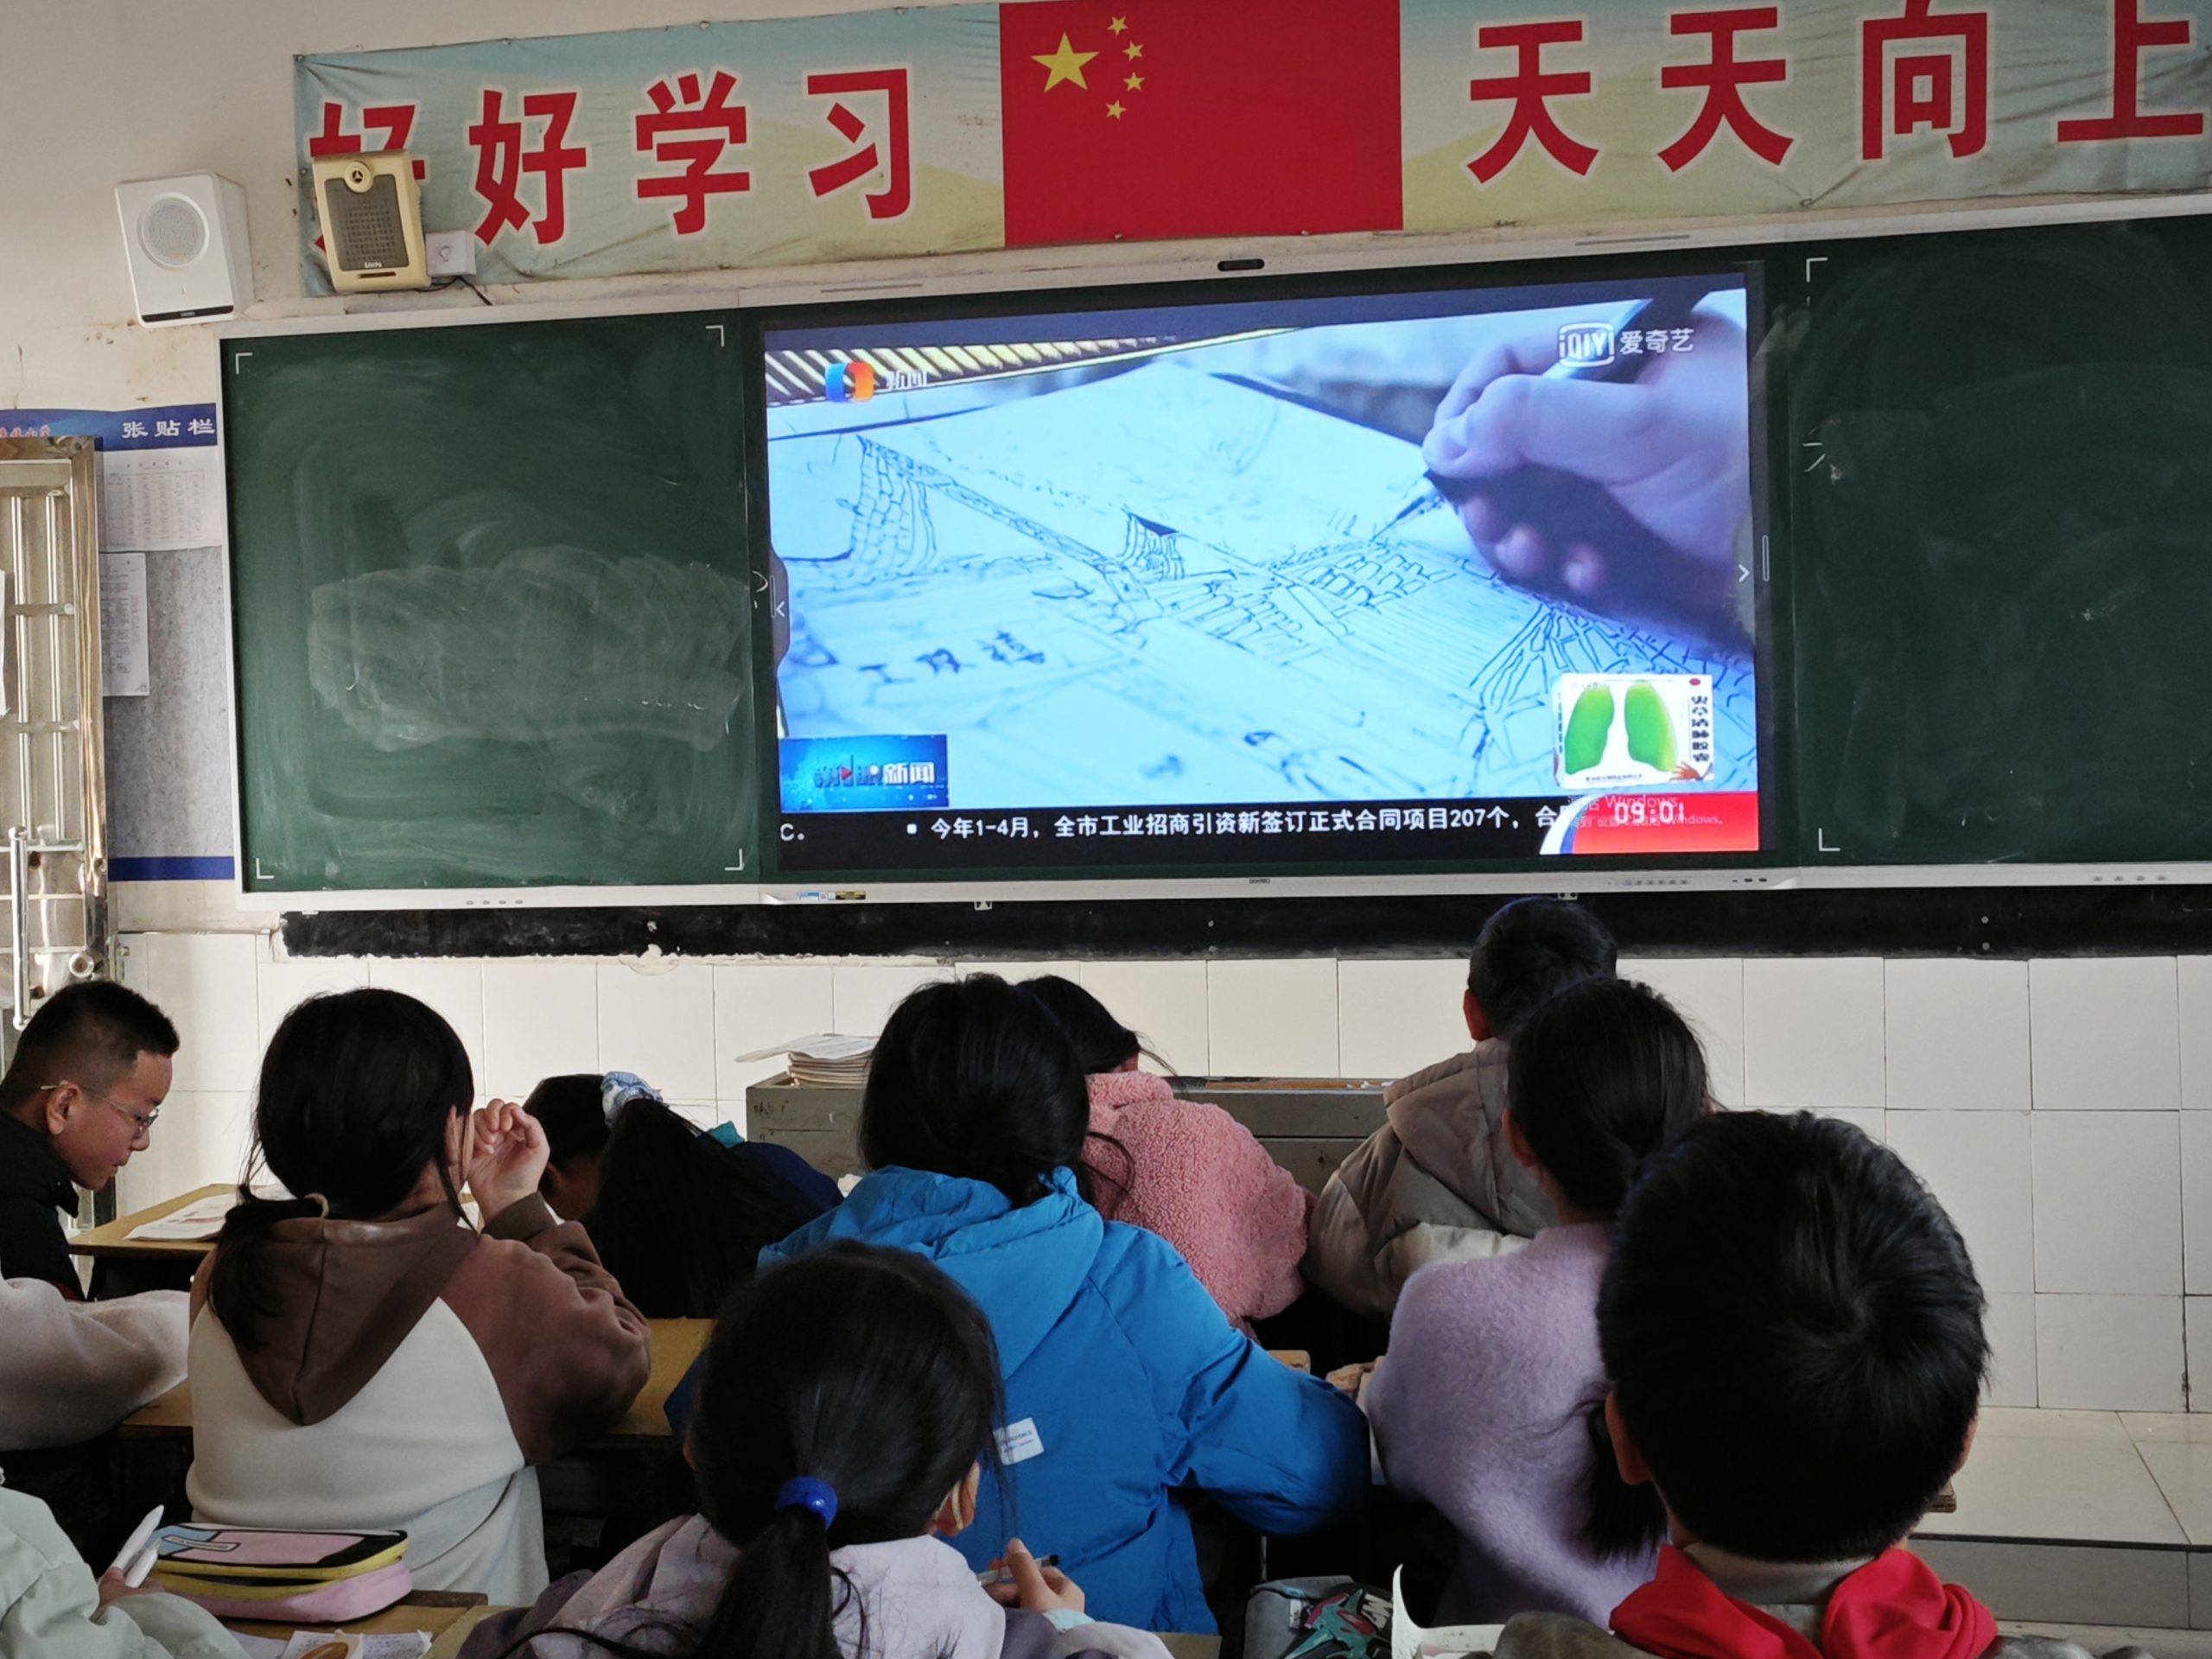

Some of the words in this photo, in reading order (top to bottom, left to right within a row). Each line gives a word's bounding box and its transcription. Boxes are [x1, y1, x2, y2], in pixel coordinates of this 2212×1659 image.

[1466, 0, 2204, 184] 天天向上
[1619, 327, 1694, 356] 爱奇艺
[122, 418, 215, 439] 张贴栏
[931, 804, 1567, 840] 今年1-4月，全市工业招商引资新签订正式合同项目207个，合
